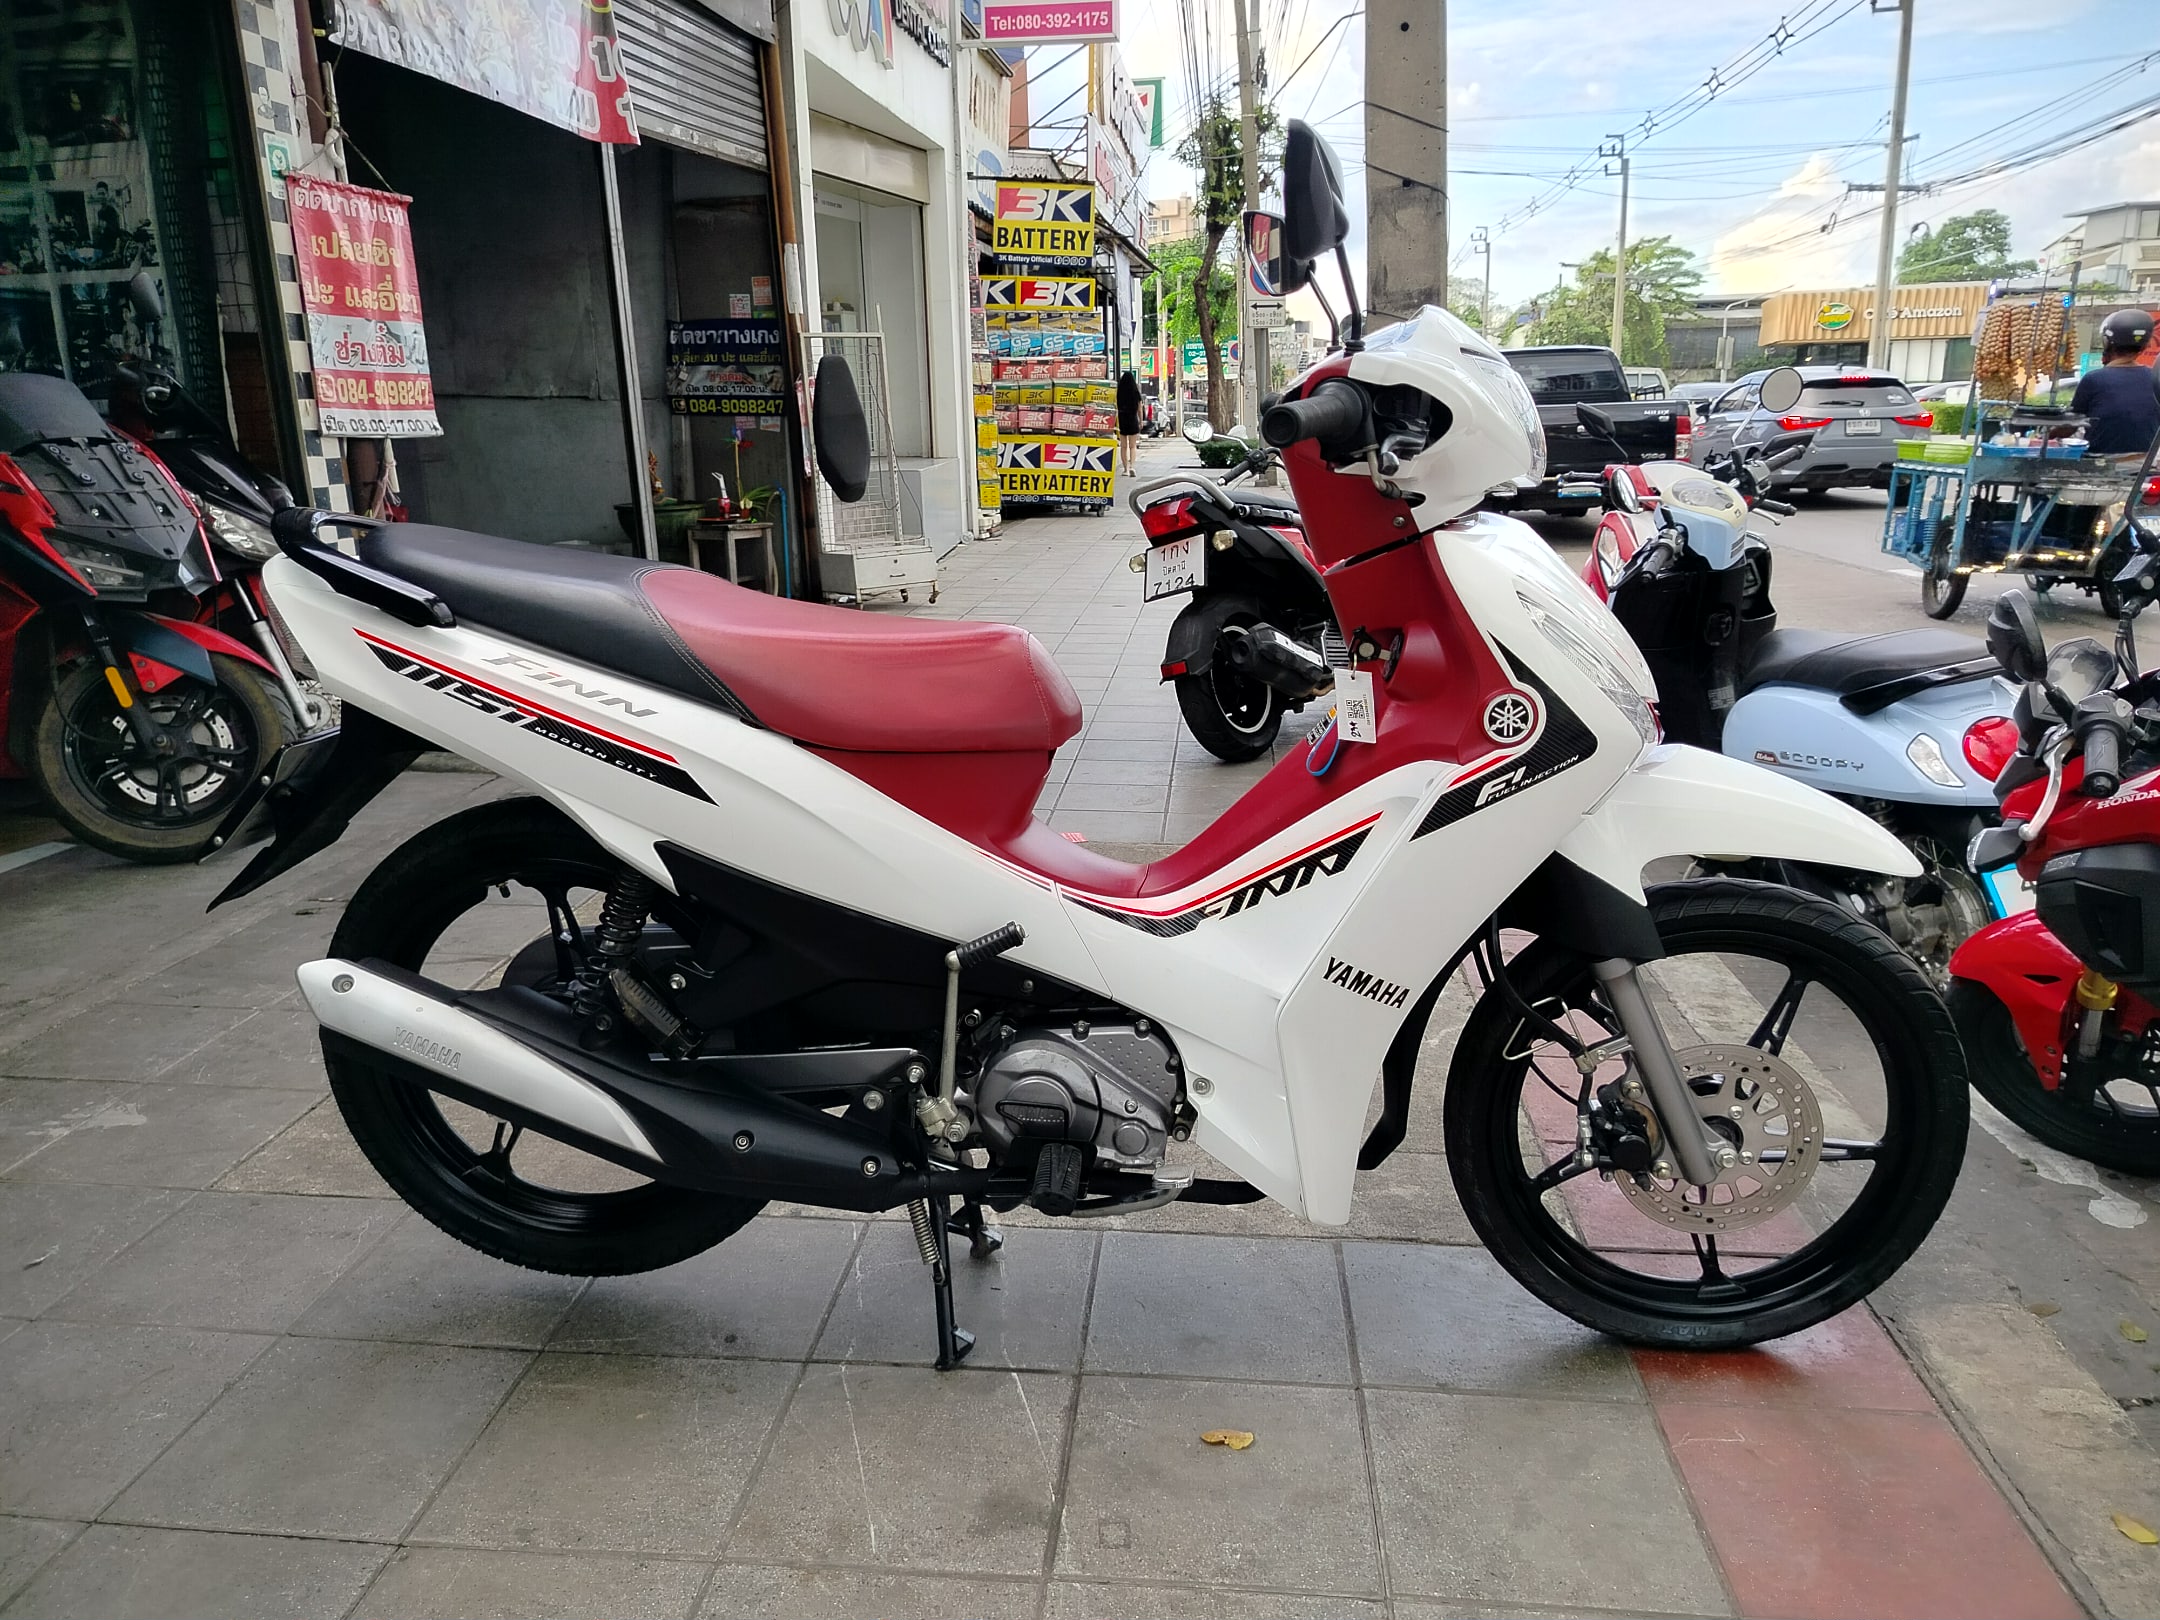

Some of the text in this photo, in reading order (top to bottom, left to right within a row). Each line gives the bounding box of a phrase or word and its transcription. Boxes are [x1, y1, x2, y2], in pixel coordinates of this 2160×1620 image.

[990, 12, 1109, 31] Tel:080-392-1175
[1000, 187, 1092, 223] 3K
[996, 226, 1090, 251] BATTERY
[1008, 255, 1030, 264] Battery
[305, 276, 334, 305] ปะ
[982, 280, 1016, 305] K
[1022, 281, 1091, 308] 3K
[1900, 306, 1962, 319] Amazon
[1011, 334, 1031, 347] GS
[1043, 336, 1065, 349] GS
[1074, 337, 1094, 350] GS
[1003, 367, 1023, 375] 3K
[1031, 366, 1049, 374] 3K
[1058, 364, 1077, 373] 3K
[1084, 363, 1103, 372] 3K
[336, 378, 430, 406] 084-9098247
[1025, 391, 1045, 399] 3K
[1091, 388, 1109, 396] 3K
[689, 399, 784, 413] 084-9098247
[1025, 412, 1044, 420] 3K
[1059, 415, 1078, 423] 3K
[1090, 414, 1109, 423] 3K
[350, 419, 424, 432] 08.00-17.00
[1045, 444, 1113, 472] 3K
[1000, 474, 1041, 490] TERY
[1154, 572, 1195, 595] 7124
[534, 726, 658, 778] MODERN CITY
[1780, 751, 1864, 771] SCOOPY
[1487, 755, 1579, 801] FUEL INJECTION
[2097, 789, 2160, 809] HONDA
[1322, 956, 1411, 1009] YAMAHA
[393, 1026, 462, 1072] YAMAHA
